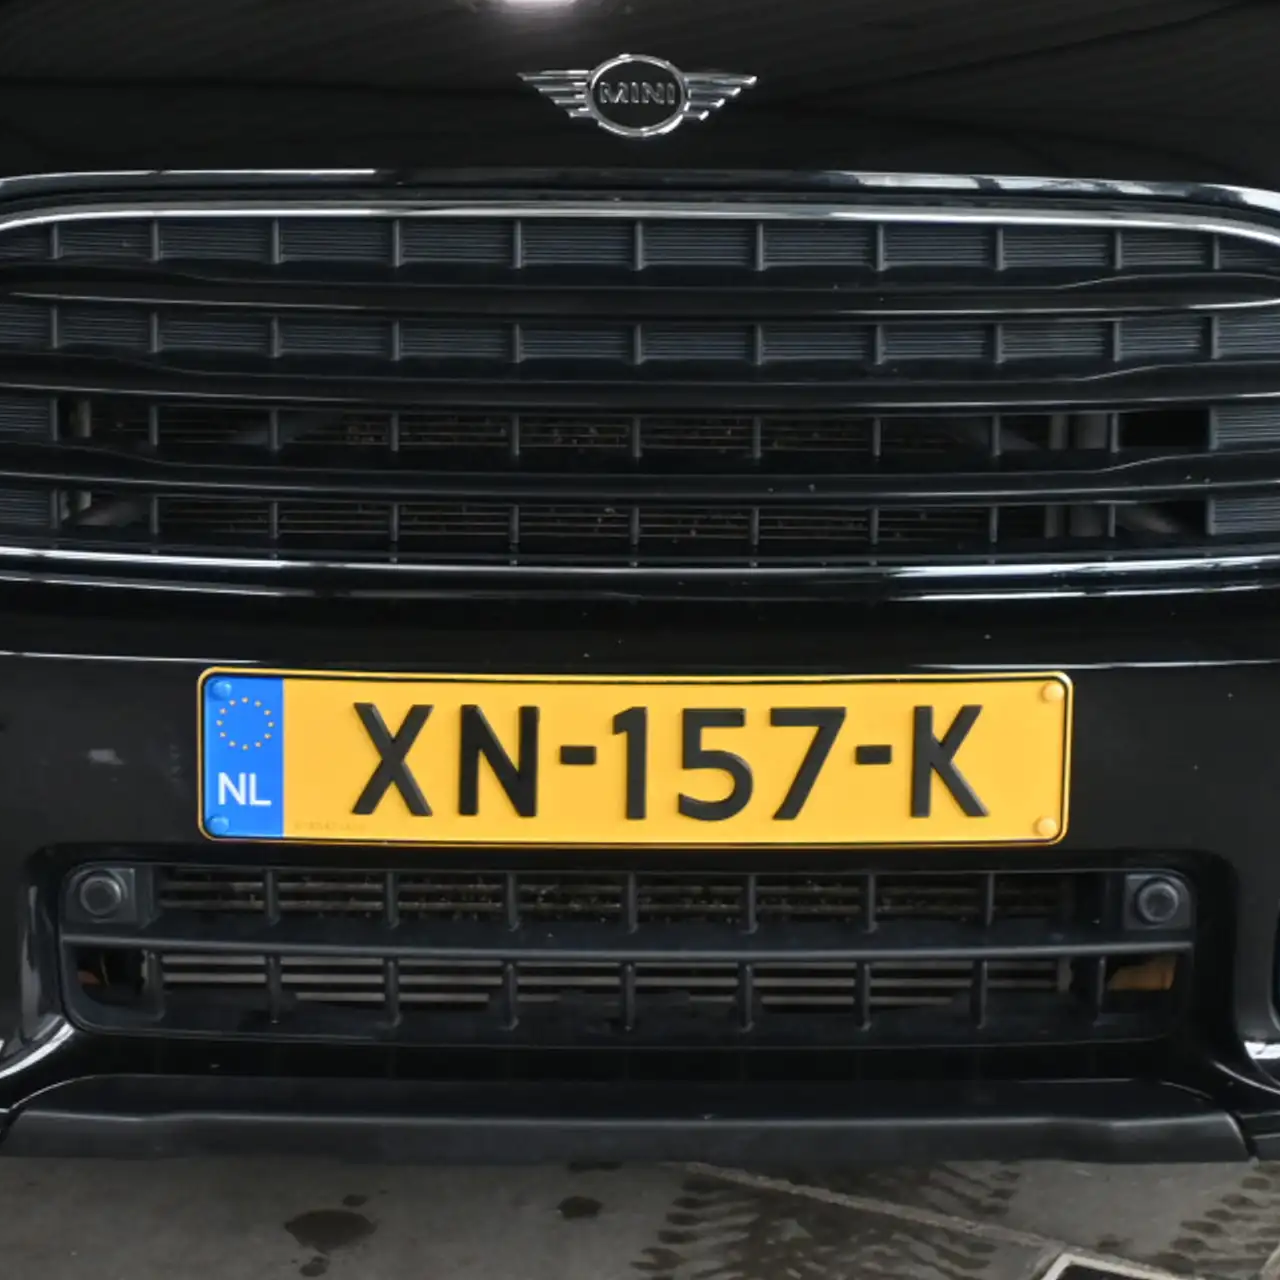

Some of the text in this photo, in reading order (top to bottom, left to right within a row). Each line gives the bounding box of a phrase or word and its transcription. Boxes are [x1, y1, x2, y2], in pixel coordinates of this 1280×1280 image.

[599, 81, 676, 104] MINI
[351, 701, 990, 822] XN-157-K
[217, 771, 273, 806] NL
